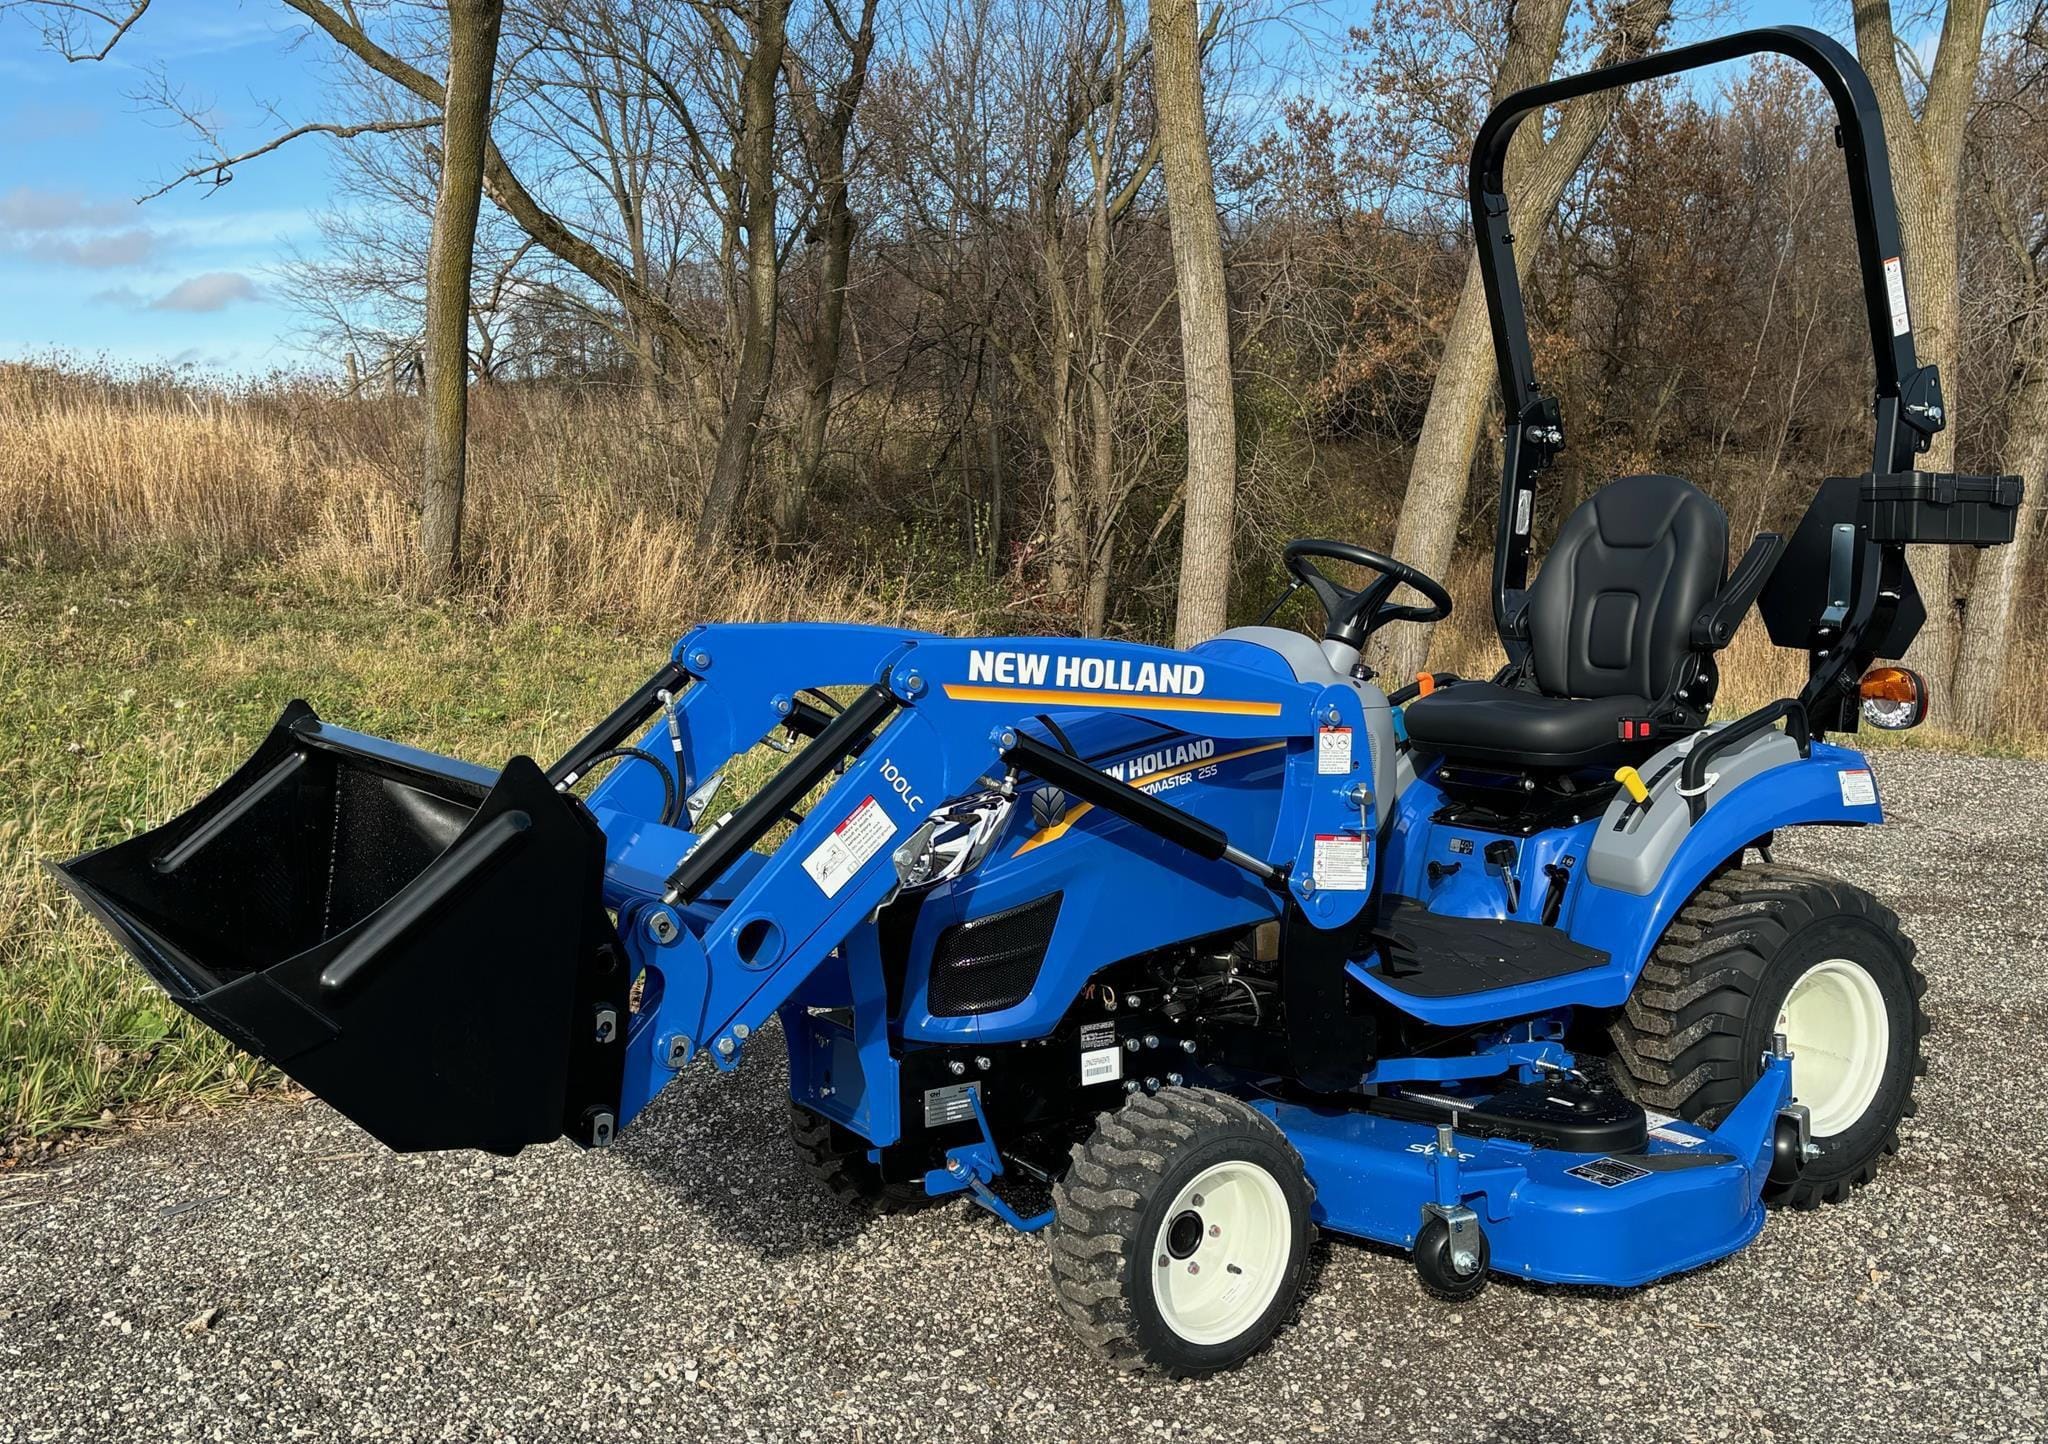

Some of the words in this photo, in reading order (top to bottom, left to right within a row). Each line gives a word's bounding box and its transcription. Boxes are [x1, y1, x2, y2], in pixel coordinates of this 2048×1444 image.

[968, 650, 1049, 685] NEW
[1055, 656, 1205, 695] HOLLAND
[1128, 738, 1215, 779] HOLLAND
[879, 758, 924, 812] 100LC
[1138, 772, 1193, 796] KMASTER
